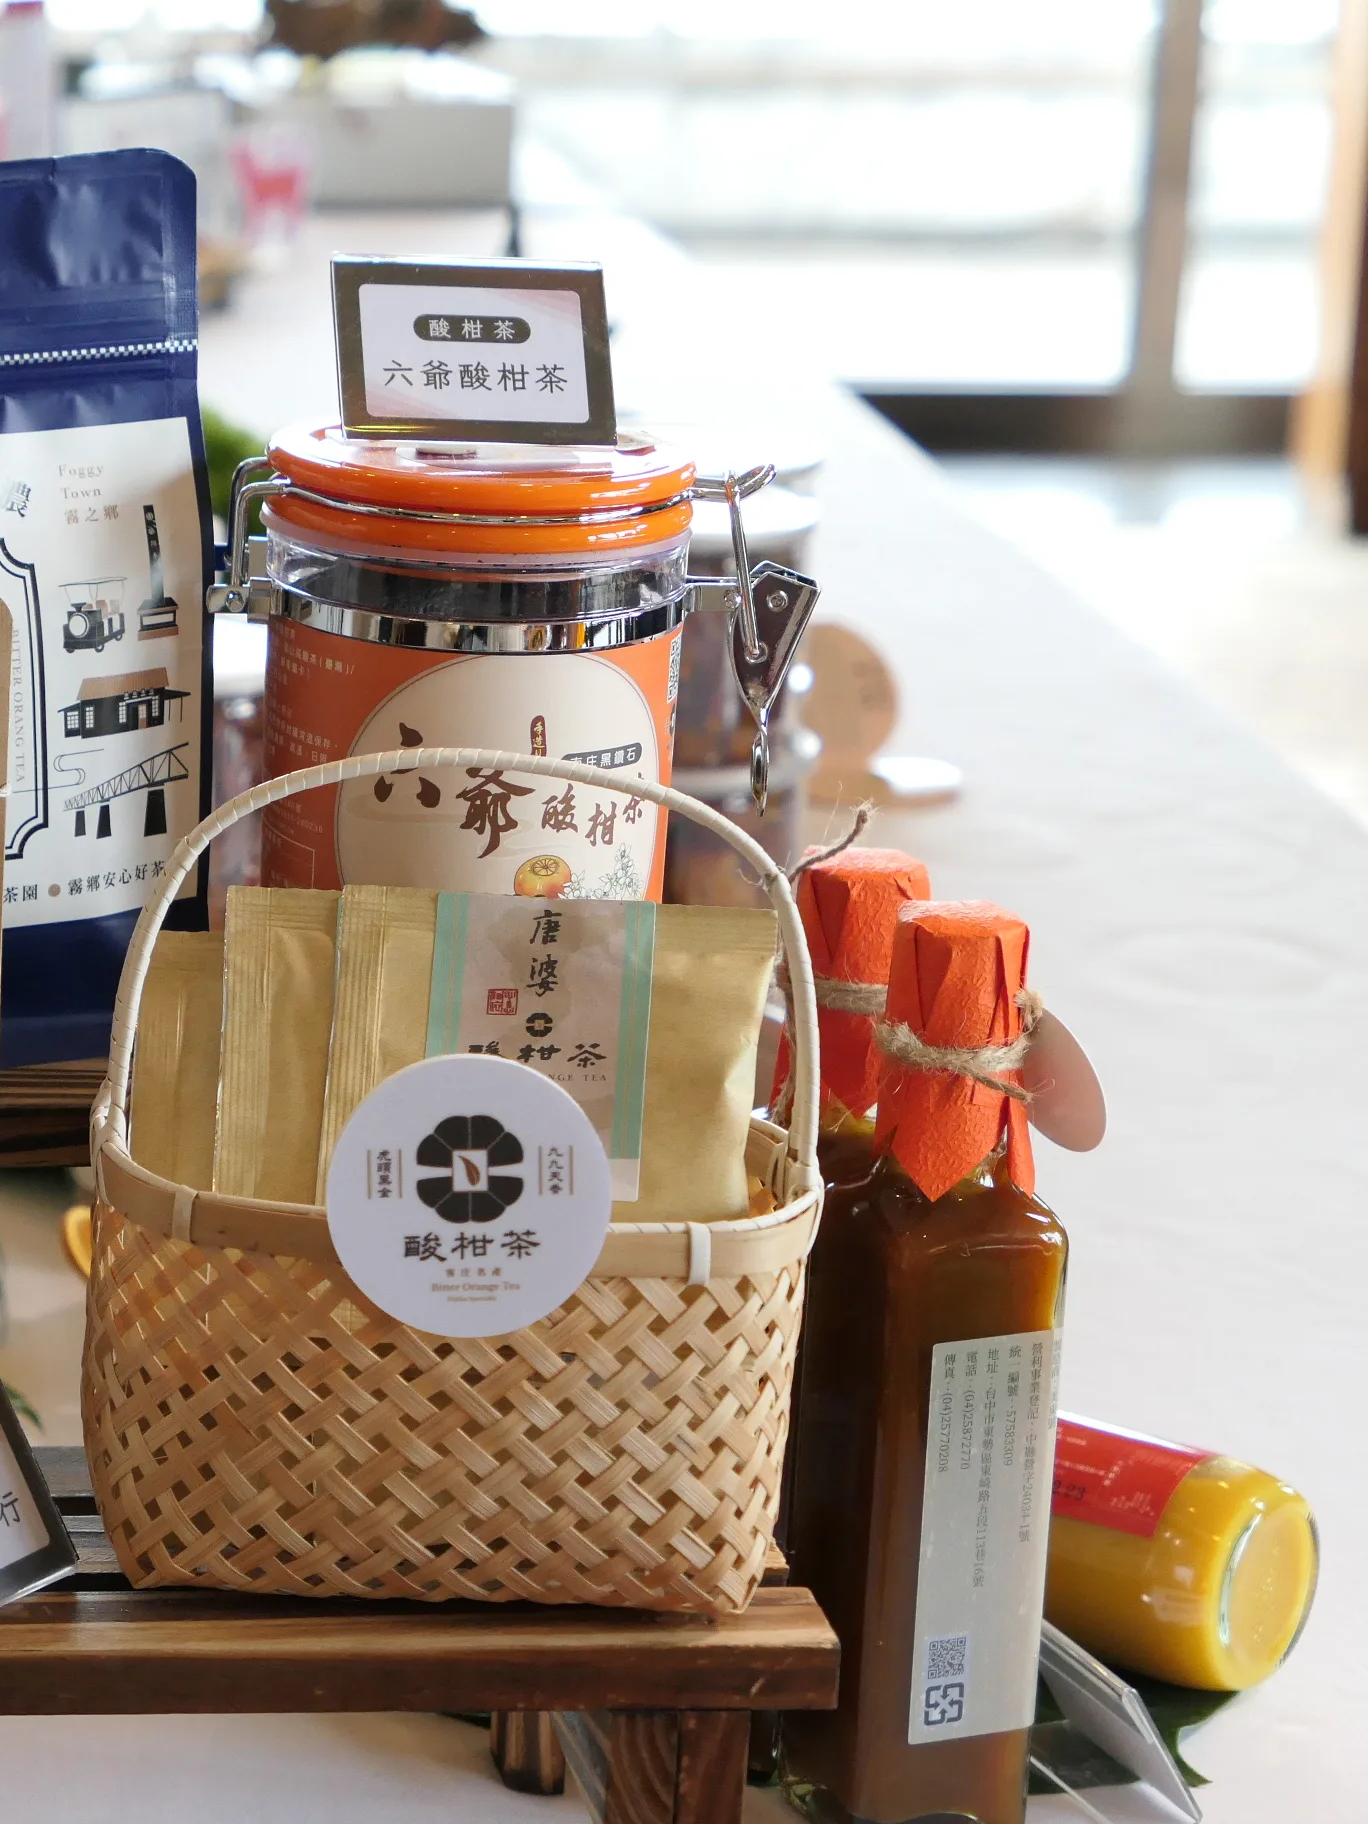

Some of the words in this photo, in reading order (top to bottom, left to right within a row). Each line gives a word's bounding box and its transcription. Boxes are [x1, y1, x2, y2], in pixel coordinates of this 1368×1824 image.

[428, 318, 516, 340] 酸柑茶
[382, 360, 568, 394] 六爺酸柑茶
[58, 463, 105, 478] Foggy
[60, 487, 102, 500] Town
[64, 504, 119, 525] 霧之鄉
[15, 753, 26, 783] TEA
[3, 884, 38, 904] 茶園
[67, 860, 167, 897] 霧鄉安心好茶
[525, 909, 563, 997] 唐婆
[583, 1073, 608, 1082] TEA
[403, 1229, 541, 1262] 酸柑茶
[462, 1281, 500, 1293] Orange
[502, 1280, 521, 1290] Tea
